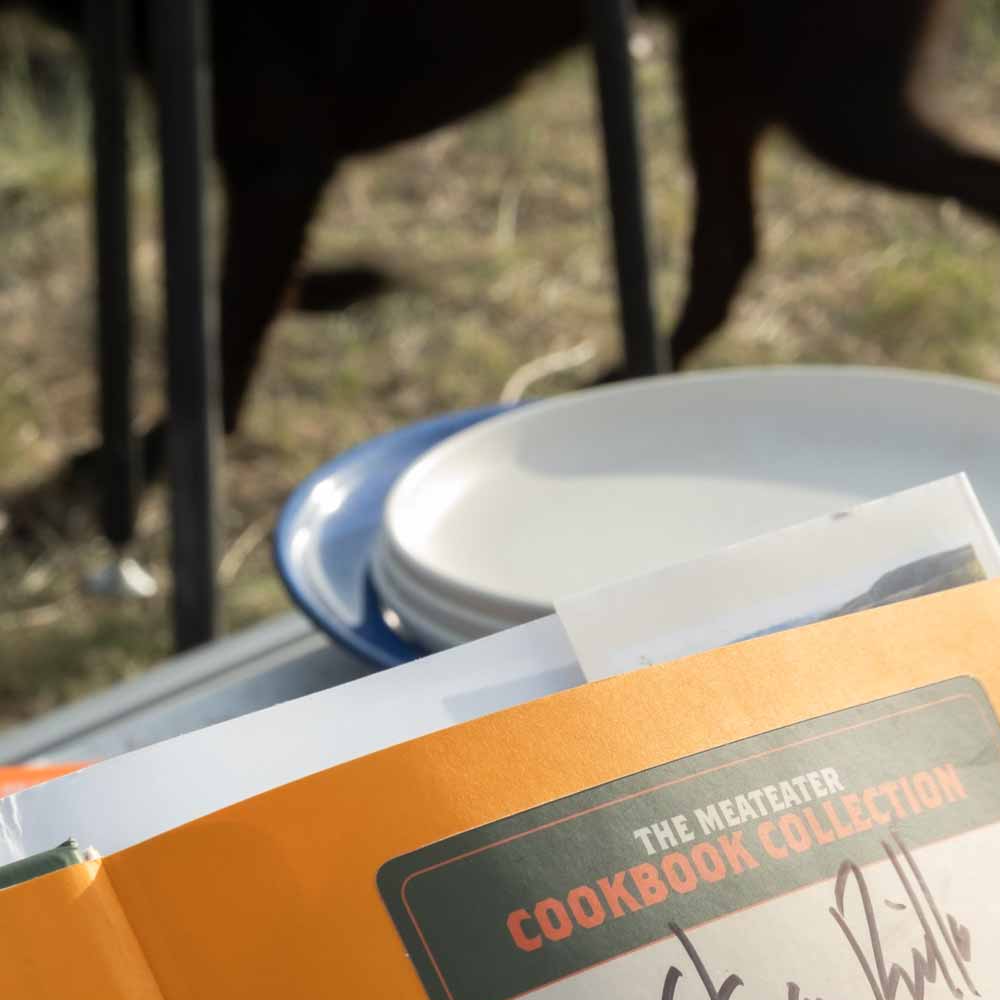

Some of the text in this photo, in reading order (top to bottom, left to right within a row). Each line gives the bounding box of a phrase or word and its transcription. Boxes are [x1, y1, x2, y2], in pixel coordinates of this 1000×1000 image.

[506, 762, 968, 952] COOKBOOK COLLECTION
[633, 767, 844, 855] THE MEATEATER
